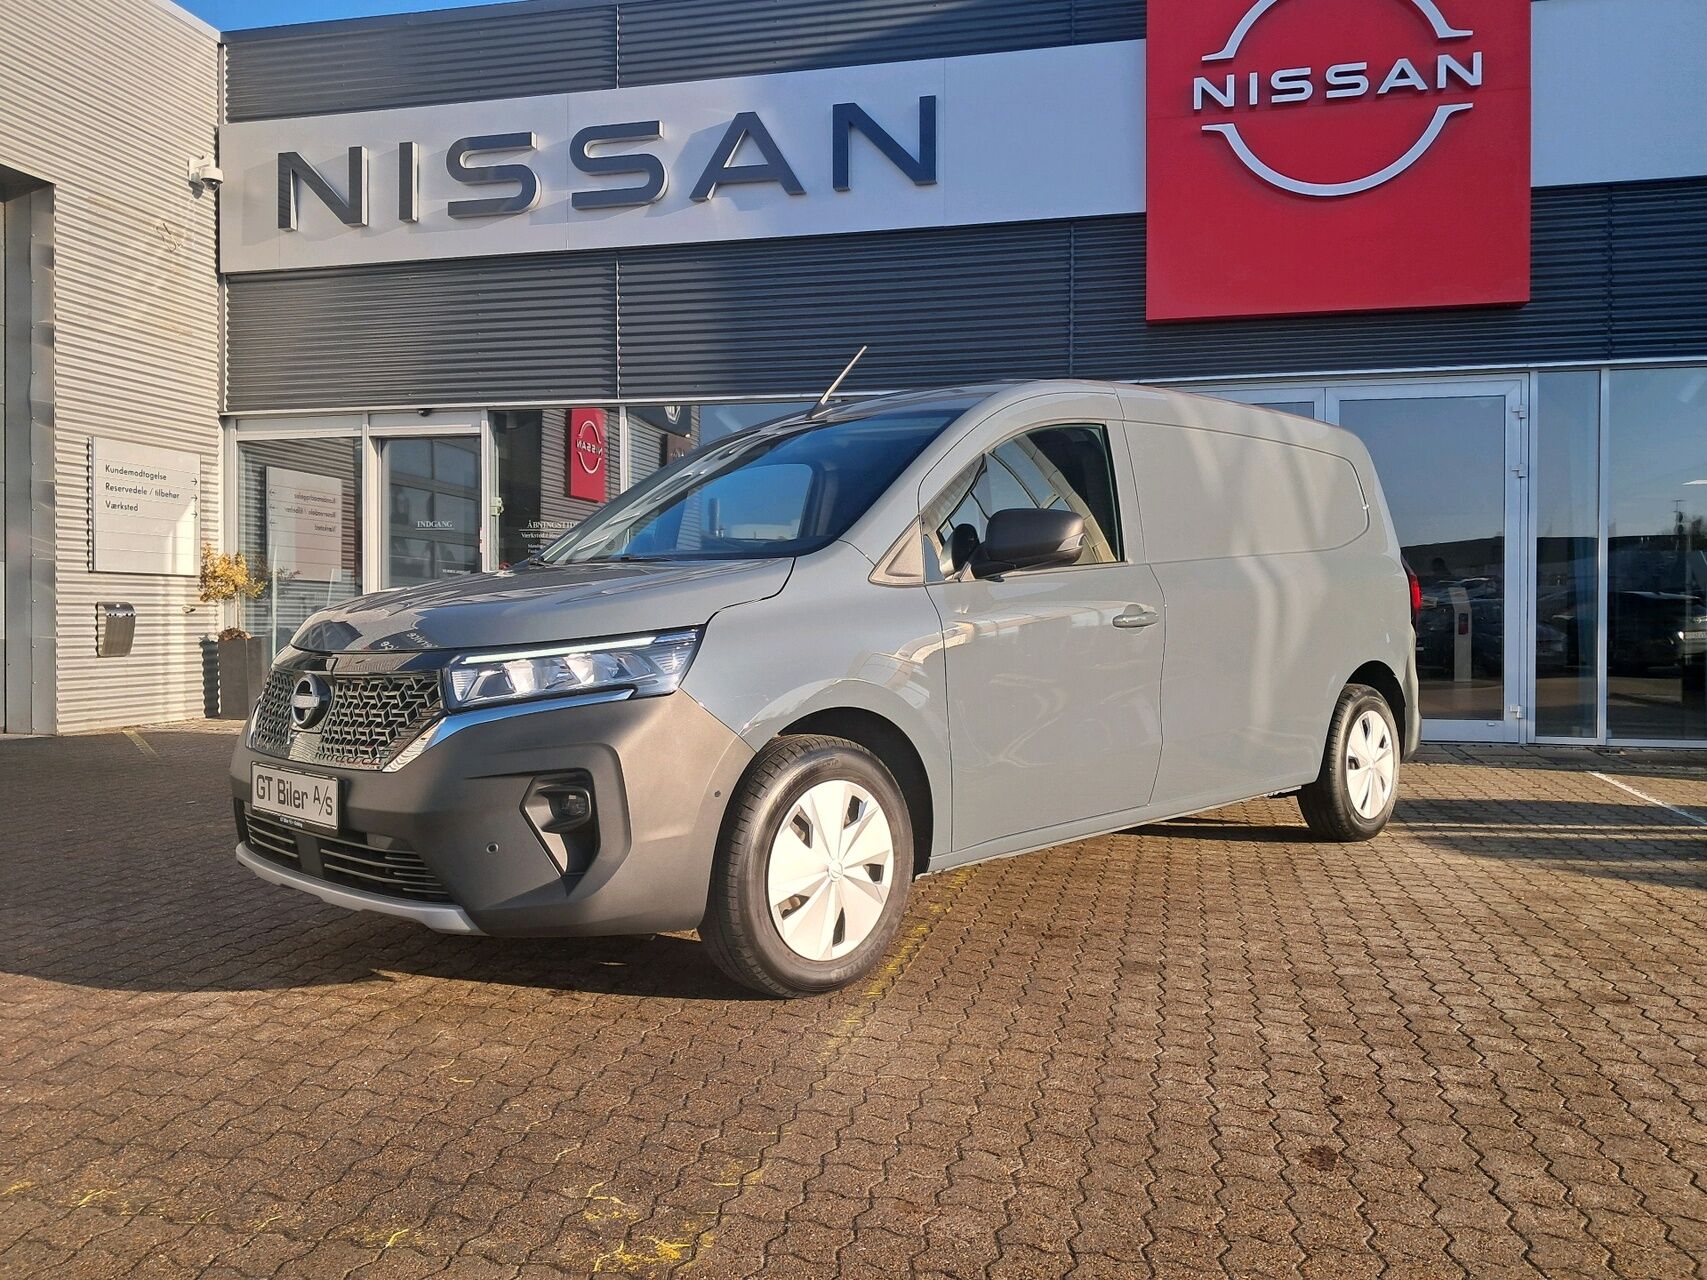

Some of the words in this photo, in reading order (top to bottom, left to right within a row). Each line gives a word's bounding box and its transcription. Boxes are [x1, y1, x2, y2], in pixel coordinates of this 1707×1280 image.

[1193, 51, 1483, 110] NISSAN
[277, 95, 938, 232] NISSAN
[105, 482, 148, 496] Reservedele
[105, 500, 139, 512] Værksted
[417, 520, 453, 528] INDGANG
[256, 774, 273, 801] GT
[277, 778, 308, 809] Biler
[313, 785, 333, 816] A/S
